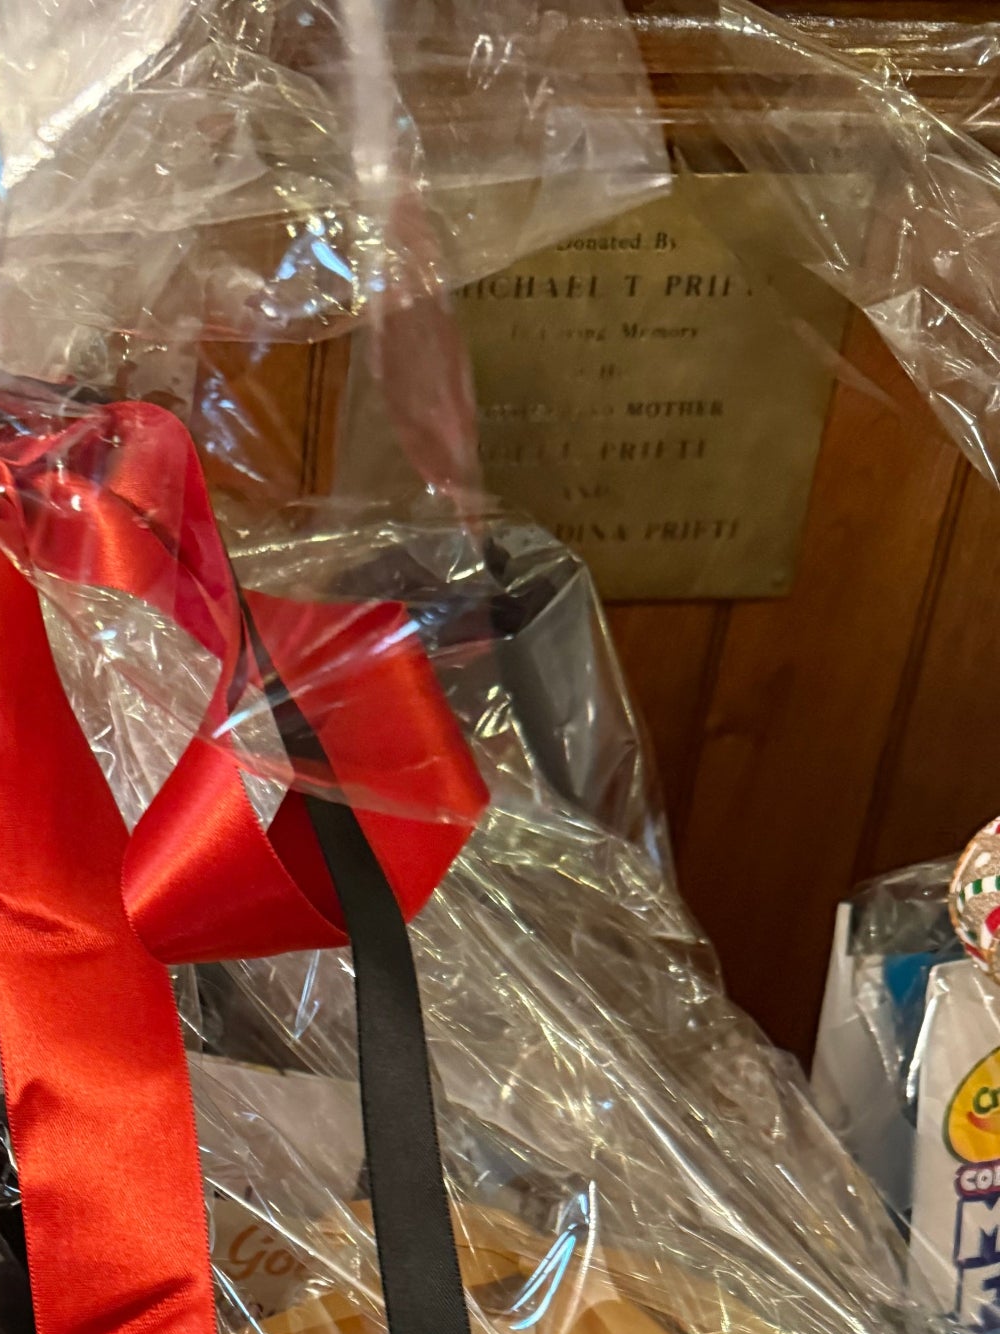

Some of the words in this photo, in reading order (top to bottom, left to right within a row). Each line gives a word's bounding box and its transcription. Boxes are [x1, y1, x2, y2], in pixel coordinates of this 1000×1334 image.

[450, 274, 599, 299] ICHAEL
[625, 275, 642, 297] T
[625, 401, 724, 418] MOTHER
